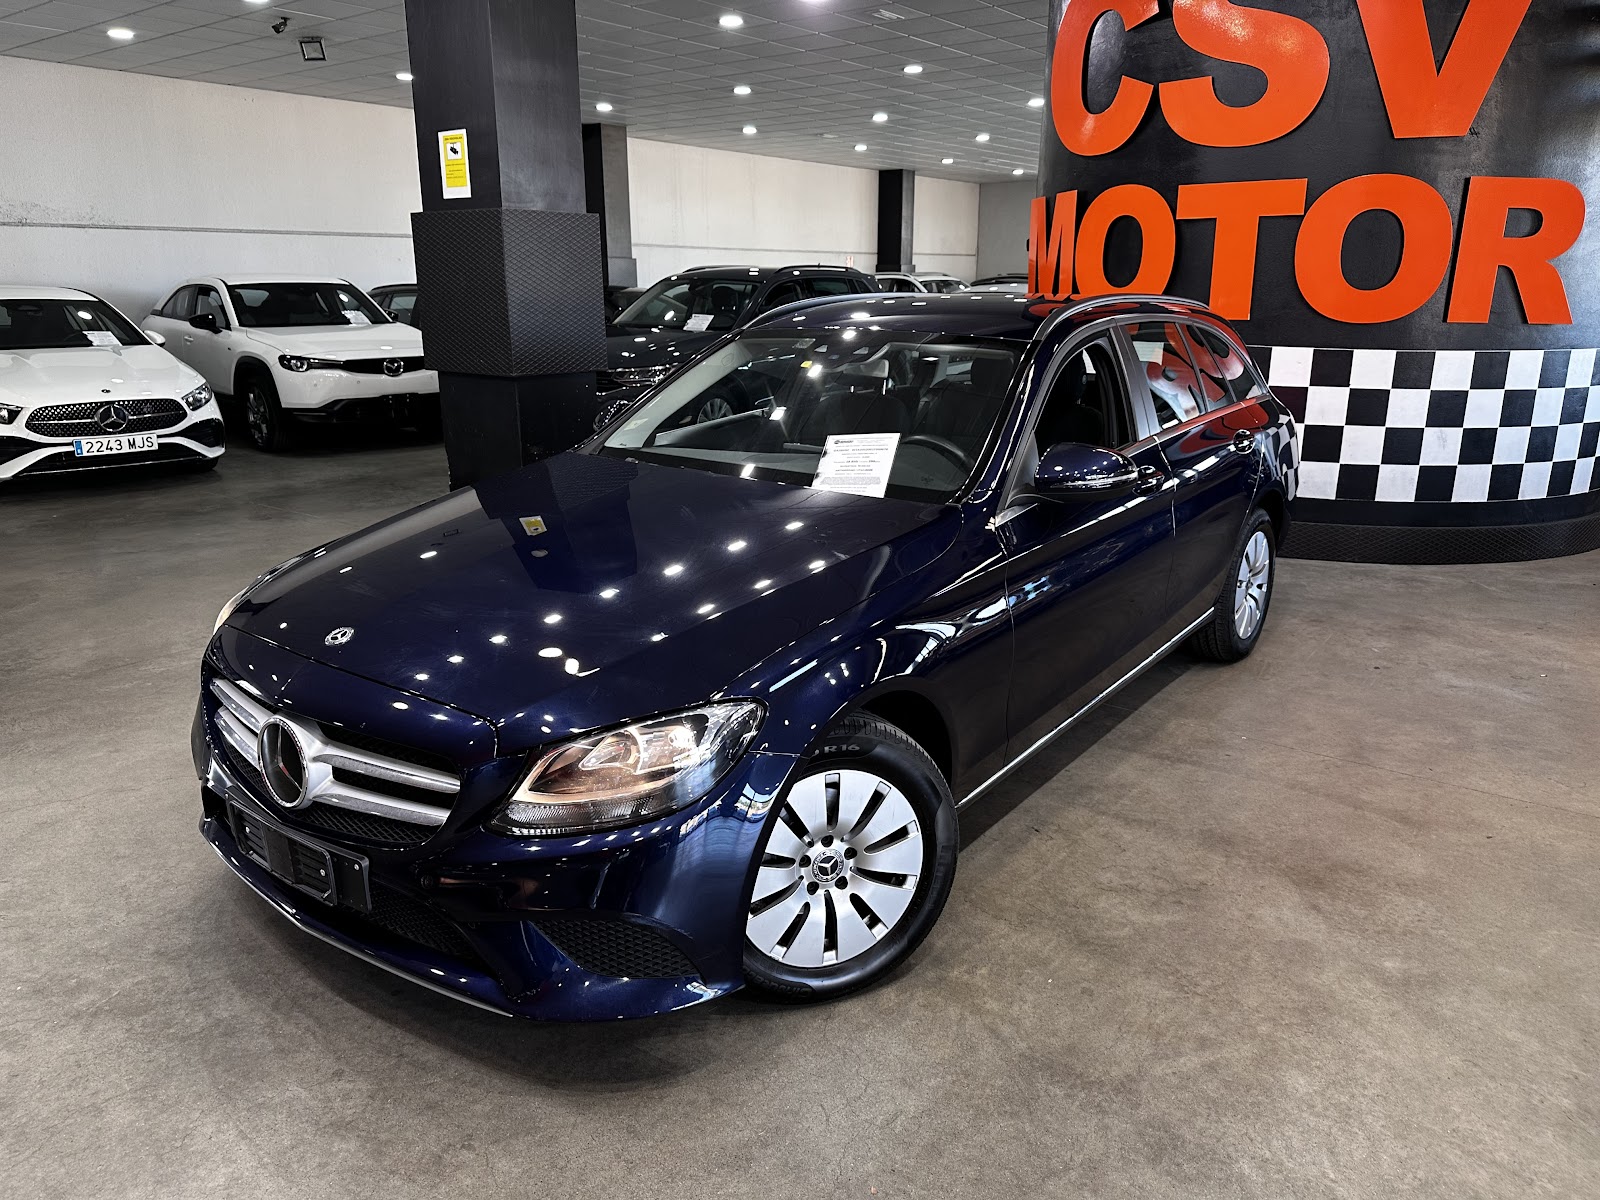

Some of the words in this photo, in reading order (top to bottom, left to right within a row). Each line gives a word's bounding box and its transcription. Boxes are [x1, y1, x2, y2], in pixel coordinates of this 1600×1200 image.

[1051, 0, 1532, 156] CSV
[1028, 174, 1586, 325] MOTOR
[85, 439, 123, 454] 2243
[127, 436, 154, 450] MJS
[823, 743, 861, 754] R16
